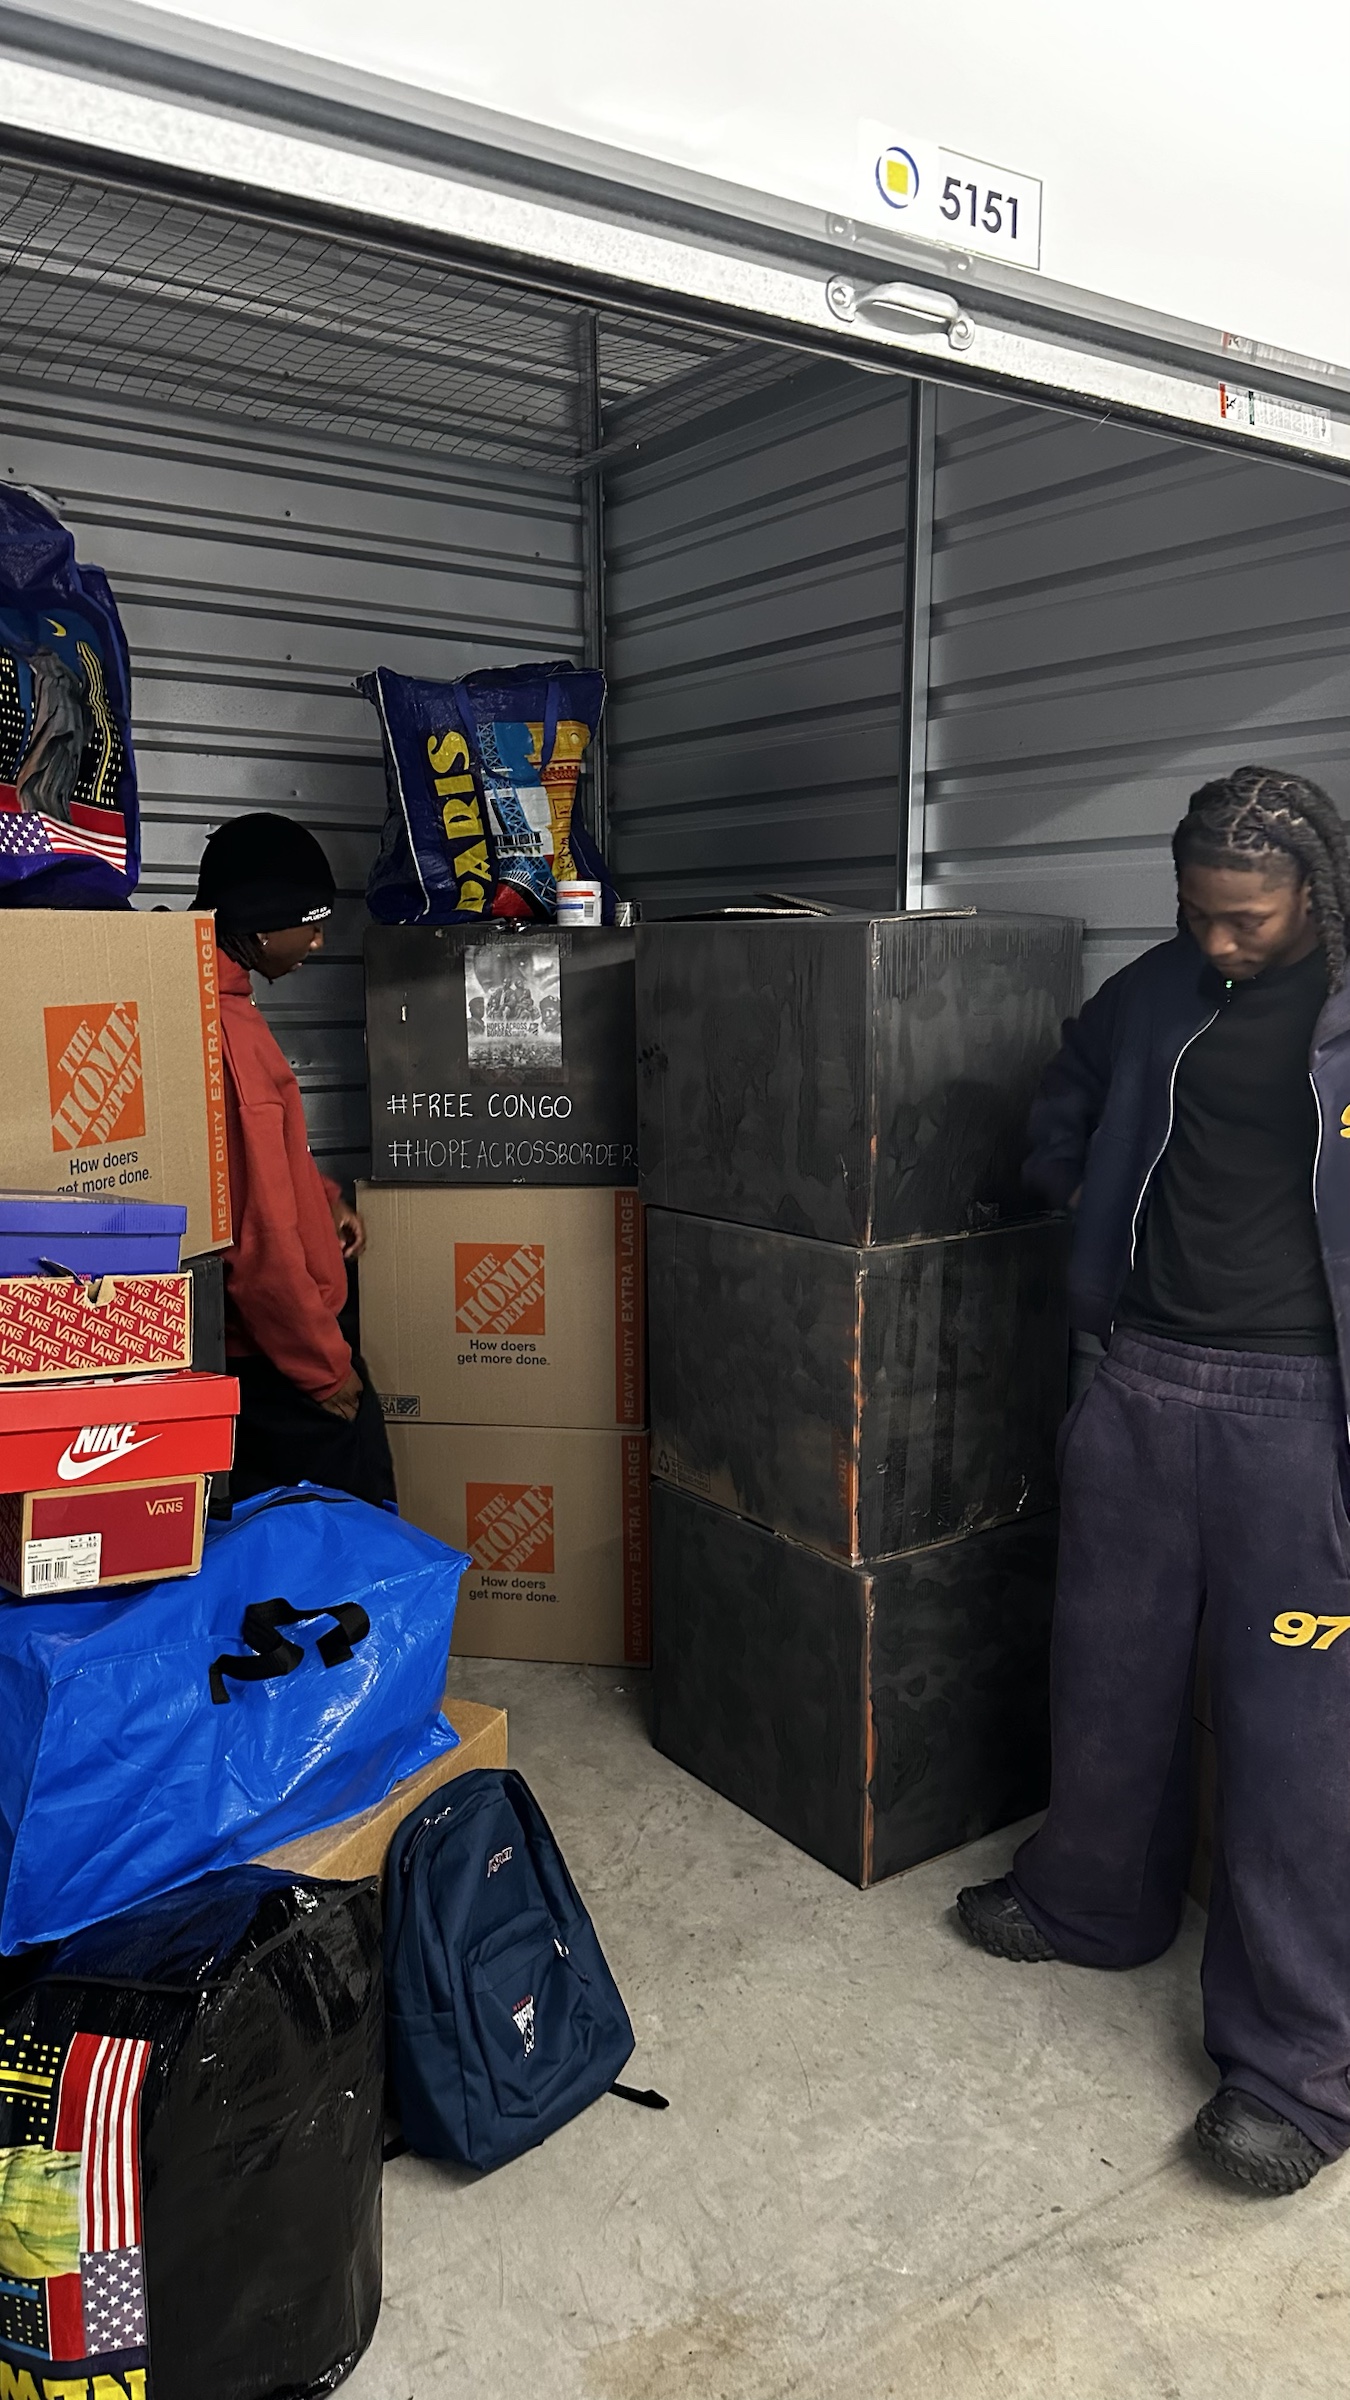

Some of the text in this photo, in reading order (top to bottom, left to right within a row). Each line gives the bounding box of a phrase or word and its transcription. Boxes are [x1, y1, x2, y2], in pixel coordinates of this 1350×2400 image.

[939, 176, 1018, 239] 5151
[427, 731, 493, 912] PARIS
[57, 1019, 97, 1078] THE
[52, 1002, 140, 1149] HOME
[200, 926, 228, 1233] HEAVY DUTY EXTRA LARGE
[91, 1052, 143, 1144] DEPOT
[387, 1093, 572, 1119] #FREE CONGO
[70, 1151, 138, 1175] How doers
[82, 1176, 115, 1192] more
[119, 1168, 152, 1185] done.
[463, 1252, 500, 1289] THE
[154, 1288, 184, 1313] VANS
[456, 1243, 544, 1334] HOME
[19, 1305, 53, 1332] VANS
[46, 1296, 80, 1323] VANS
[106, 1304, 137, 1330] VANS
[130, 1296, 161, 1322] VANS
[491, 1278, 545, 1334] DEPOT
[621, 1197, 634, 1418] HEAVY DUTY EXTRA LARGE
[56, 1321, 89, 1348] VANS
[82, 1313, 113, 1339] VANS
[139, 1320, 170, 1346] VANS
[1, 1339, 36, 1366] VANS
[29, 1330, 63, 1357] VANS
[91, 1337, 123, 1363] VANS
[115, 1328, 147, 1354] VANS
[470, 1339, 536, 1351] How doers
[457, 1354, 550, 1365] get more done.
[72, 1422, 139, 1454] NIKE
[145, 1497, 184, 1516] VANS
[474, 1492, 510, 1527] THE
[468, 1485, 553, 1570] HOME
[501, 1518, 553, 1572] DEPOT
[628, 1440, 642, 1656] HEAVY DUTY EXTRA LARGE
[469, 1589, 560, 1602] get more done.
[481, 1576, 546, 1589] How doers
